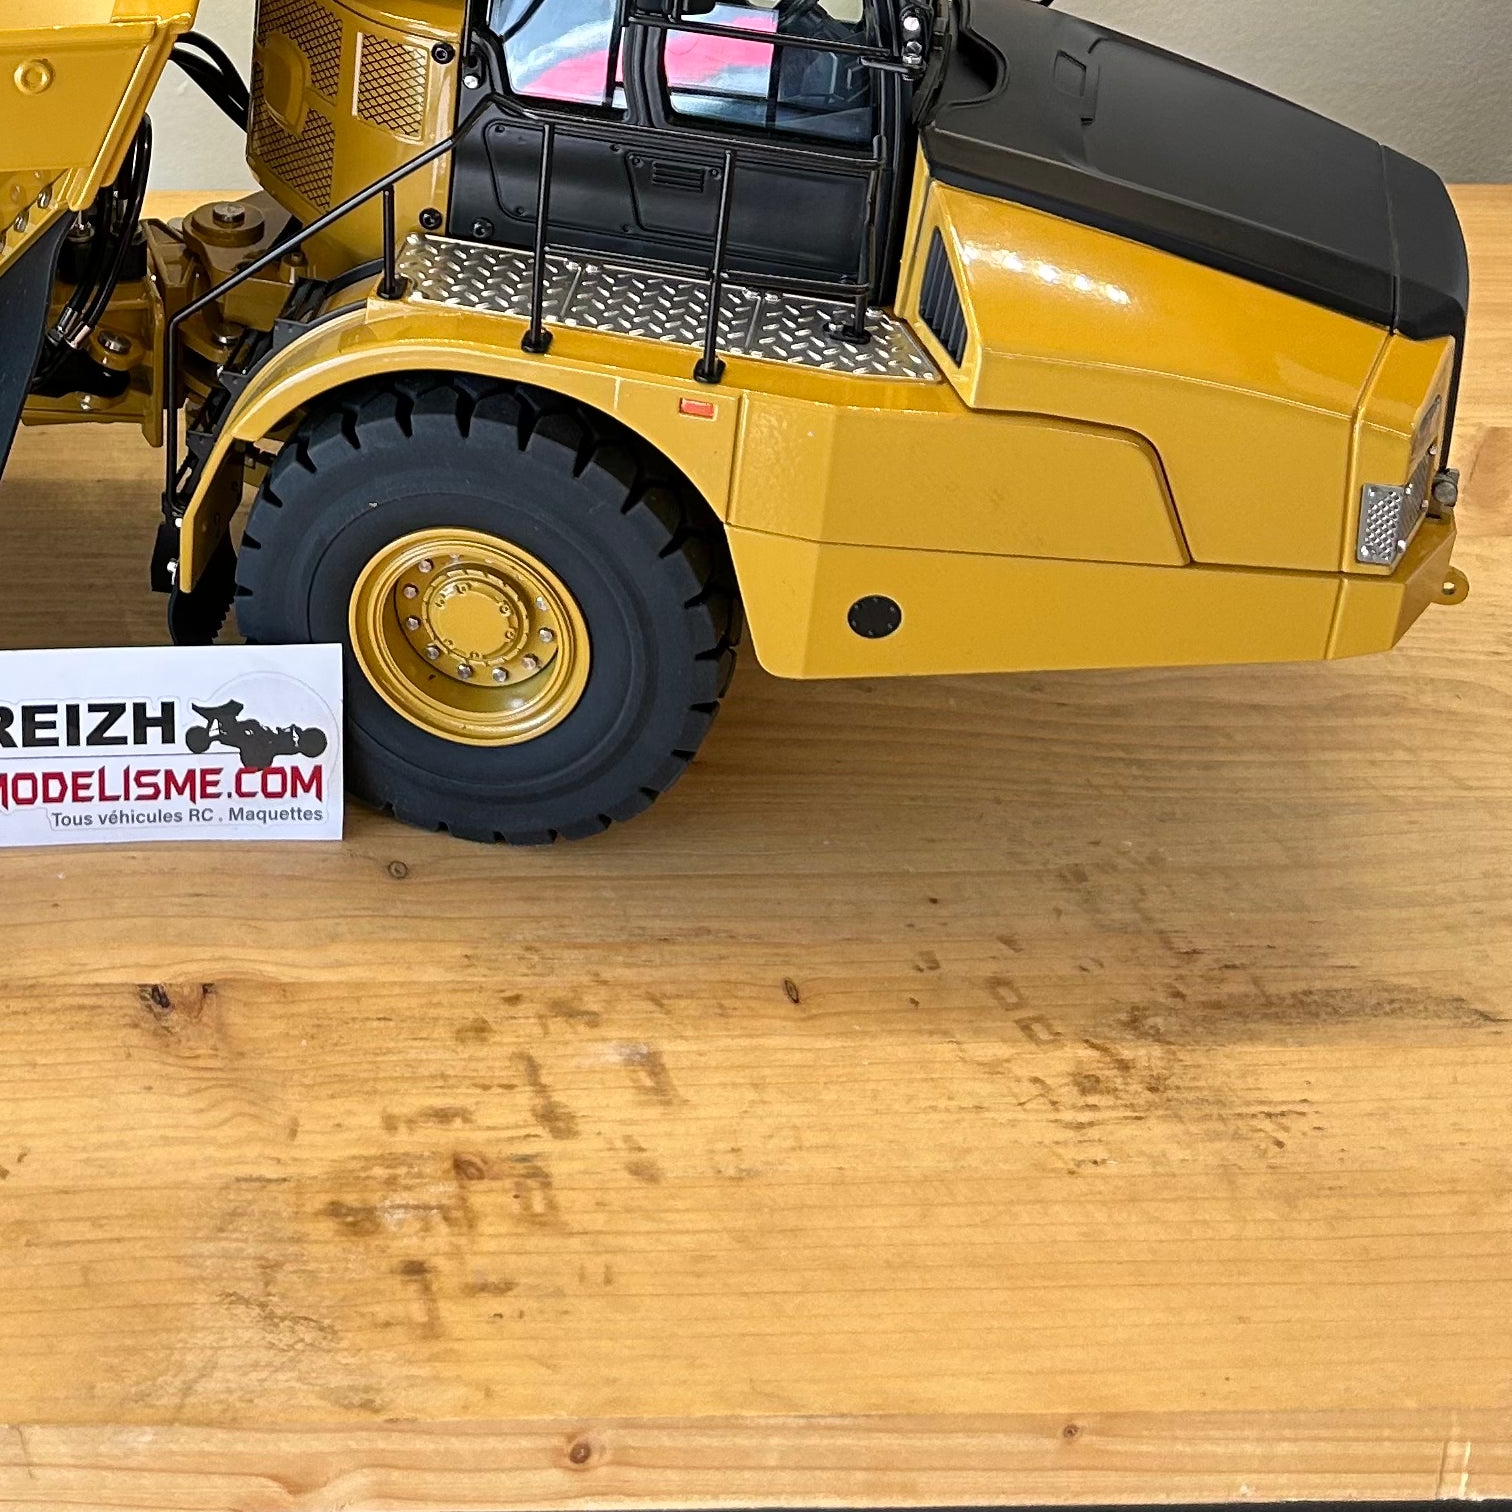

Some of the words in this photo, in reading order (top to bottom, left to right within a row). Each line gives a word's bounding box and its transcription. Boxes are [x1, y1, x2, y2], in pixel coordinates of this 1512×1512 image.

[51, 812, 93, 828] Tous
[98, 809, 183, 826] véhicules
[188, 807, 214, 823] RC
[228, 806, 323, 826] Maquettes
